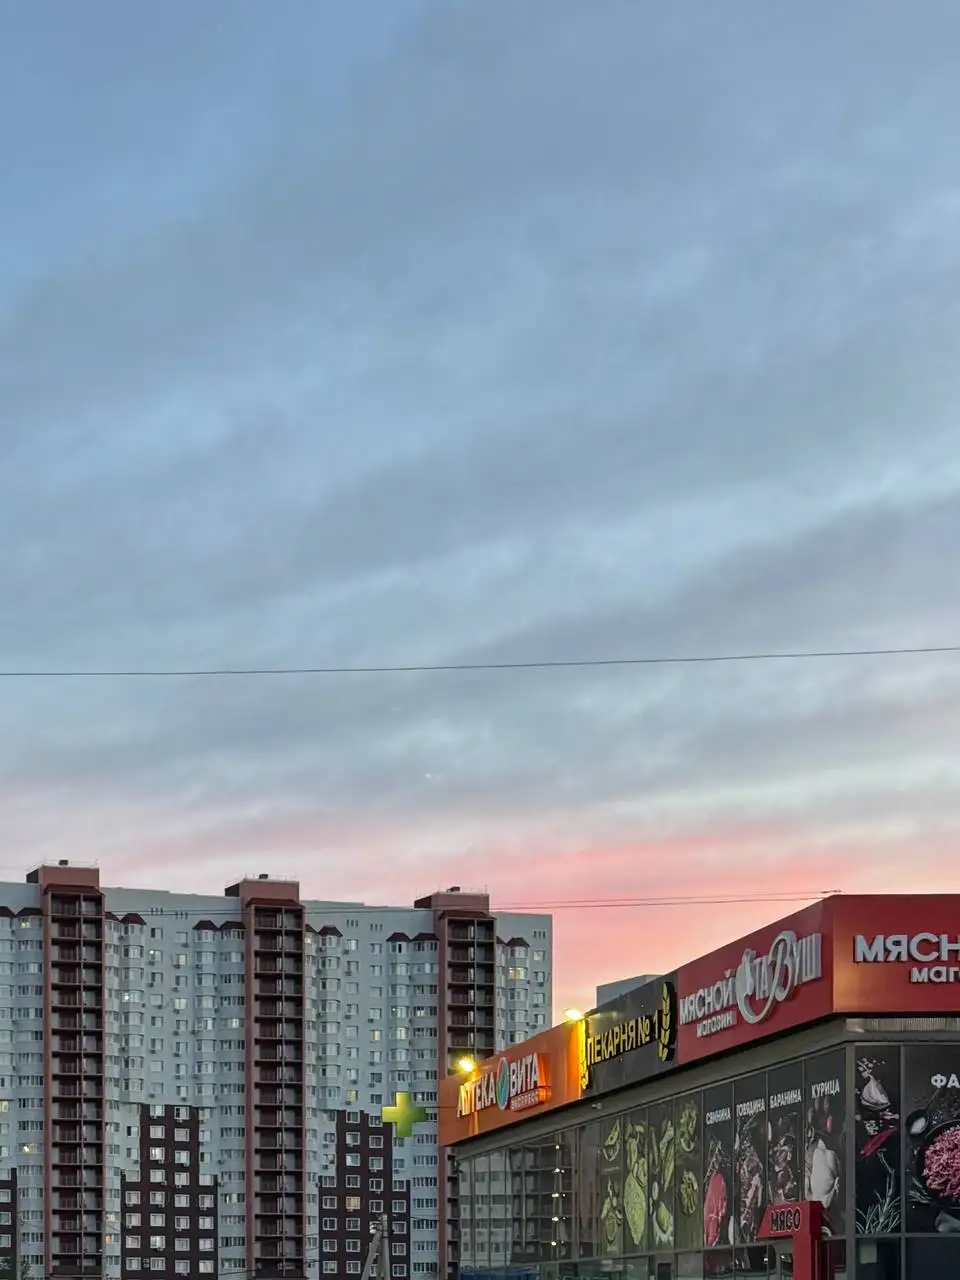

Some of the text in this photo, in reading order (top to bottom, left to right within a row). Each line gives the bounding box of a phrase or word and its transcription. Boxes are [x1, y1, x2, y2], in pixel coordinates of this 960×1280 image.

[910, 966, 960, 983] маг
[679, 969, 734, 1026] МЯСНОЙ
[587, 1008, 659, 1066] ПЕКАРНЯ № 1
[456, 1051, 540, 1118] АПТЕКА ВИТА
[811, 1078, 840, 1099] КУРИЦА
[736, 1098, 766, 1118] ГОВЯДИНА
[769, 1088, 802, 1109] БАРАНИНА
[705, 1107, 731, 1125] СВИНИНА
[770, 1206, 801, 1233] МЯСО
